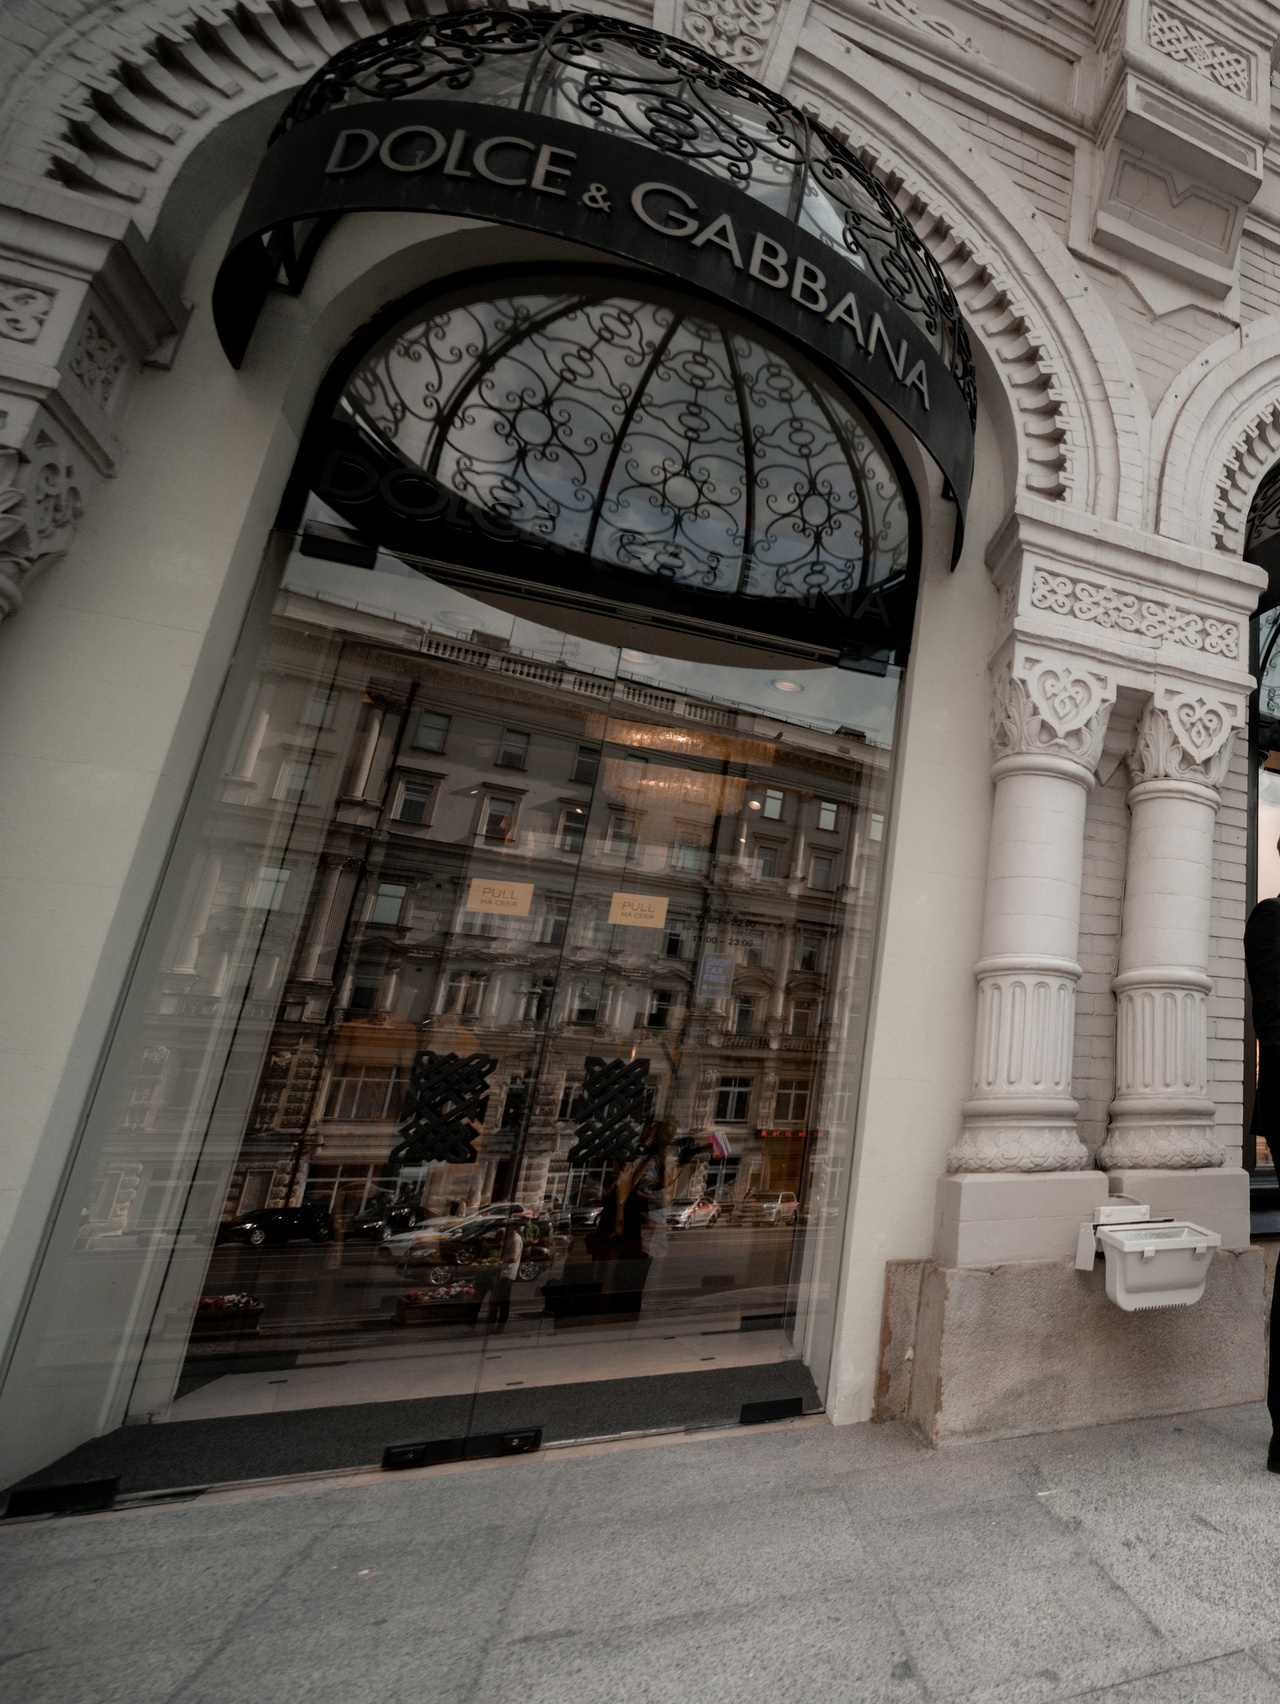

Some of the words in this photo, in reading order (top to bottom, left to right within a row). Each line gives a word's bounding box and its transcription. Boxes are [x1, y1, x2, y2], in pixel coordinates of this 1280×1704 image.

[325, 125, 577, 197] DOLCE
[581, 182, 612, 214] &
[631, 182, 931, 412] GABBANA
[482, 887, 518, 900] PULL
[495, 899, 518, 907] СЕБЯ
[622, 901, 655, 913] PULL
[729, 938, 753, 947] 23:00
[705, 965, 724, 974] TAX
[703, 974, 727, 983] FREE
